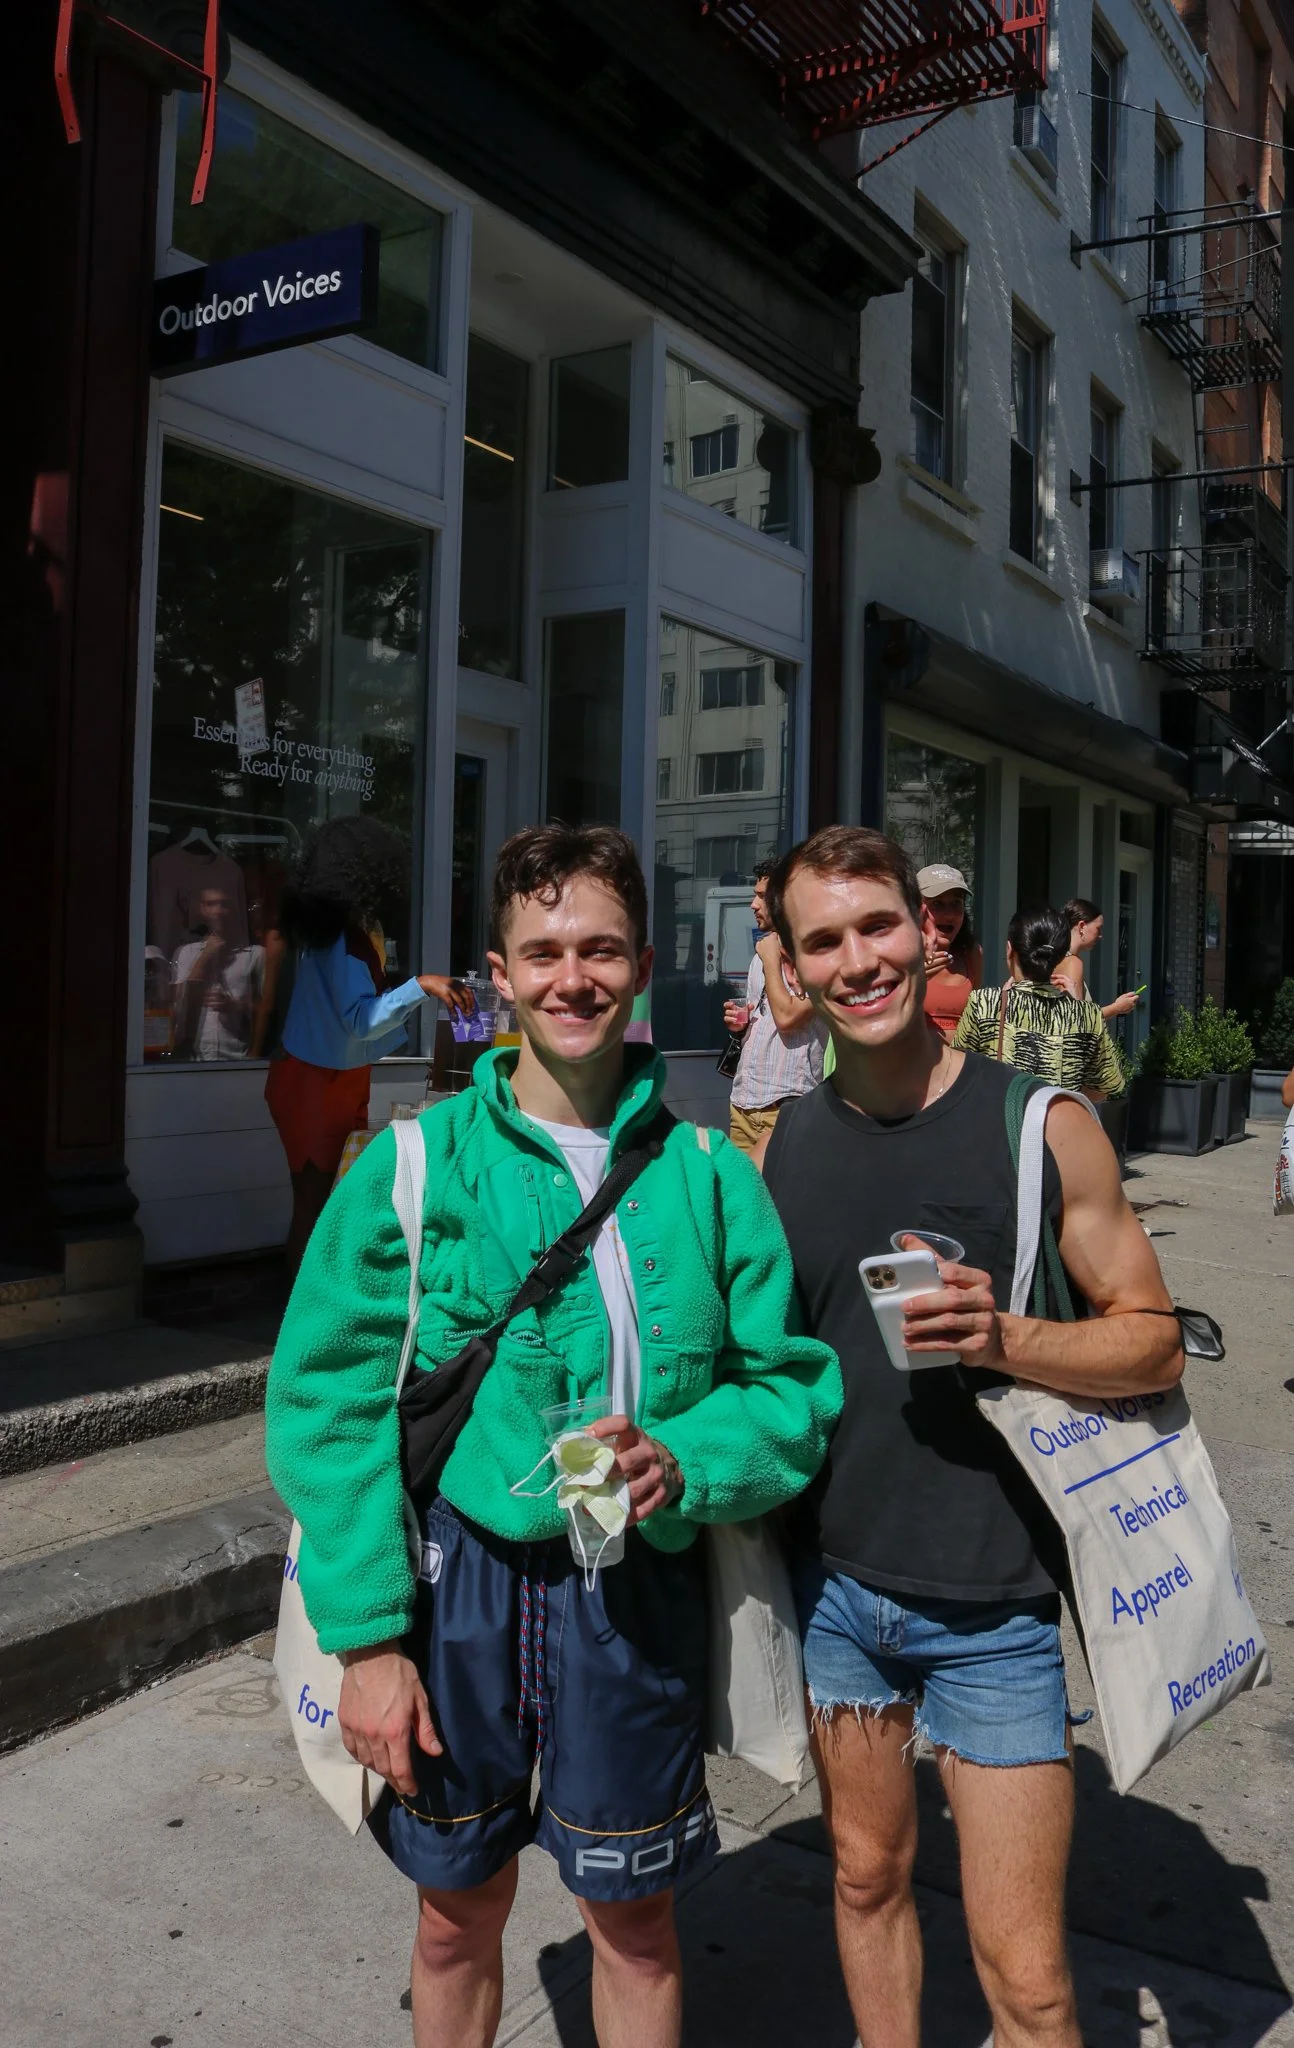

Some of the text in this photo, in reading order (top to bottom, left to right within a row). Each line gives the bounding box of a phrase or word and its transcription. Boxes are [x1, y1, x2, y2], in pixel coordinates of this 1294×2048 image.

[159, 270, 341, 336] Outdoor Voices
[192, 716, 377, 778] Essens for everything.
[239, 754, 376, 802] Ready for anything.
[1030, 1392, 1165, 1456] Outdoor Voies
[1109, 1472, 1190, 1538] Technical
[1111, 1553, 1194, 1625] Apparel
[297, 1684, 334, 1729] for
[1167, 1636, 1256, 1717] Recreation
